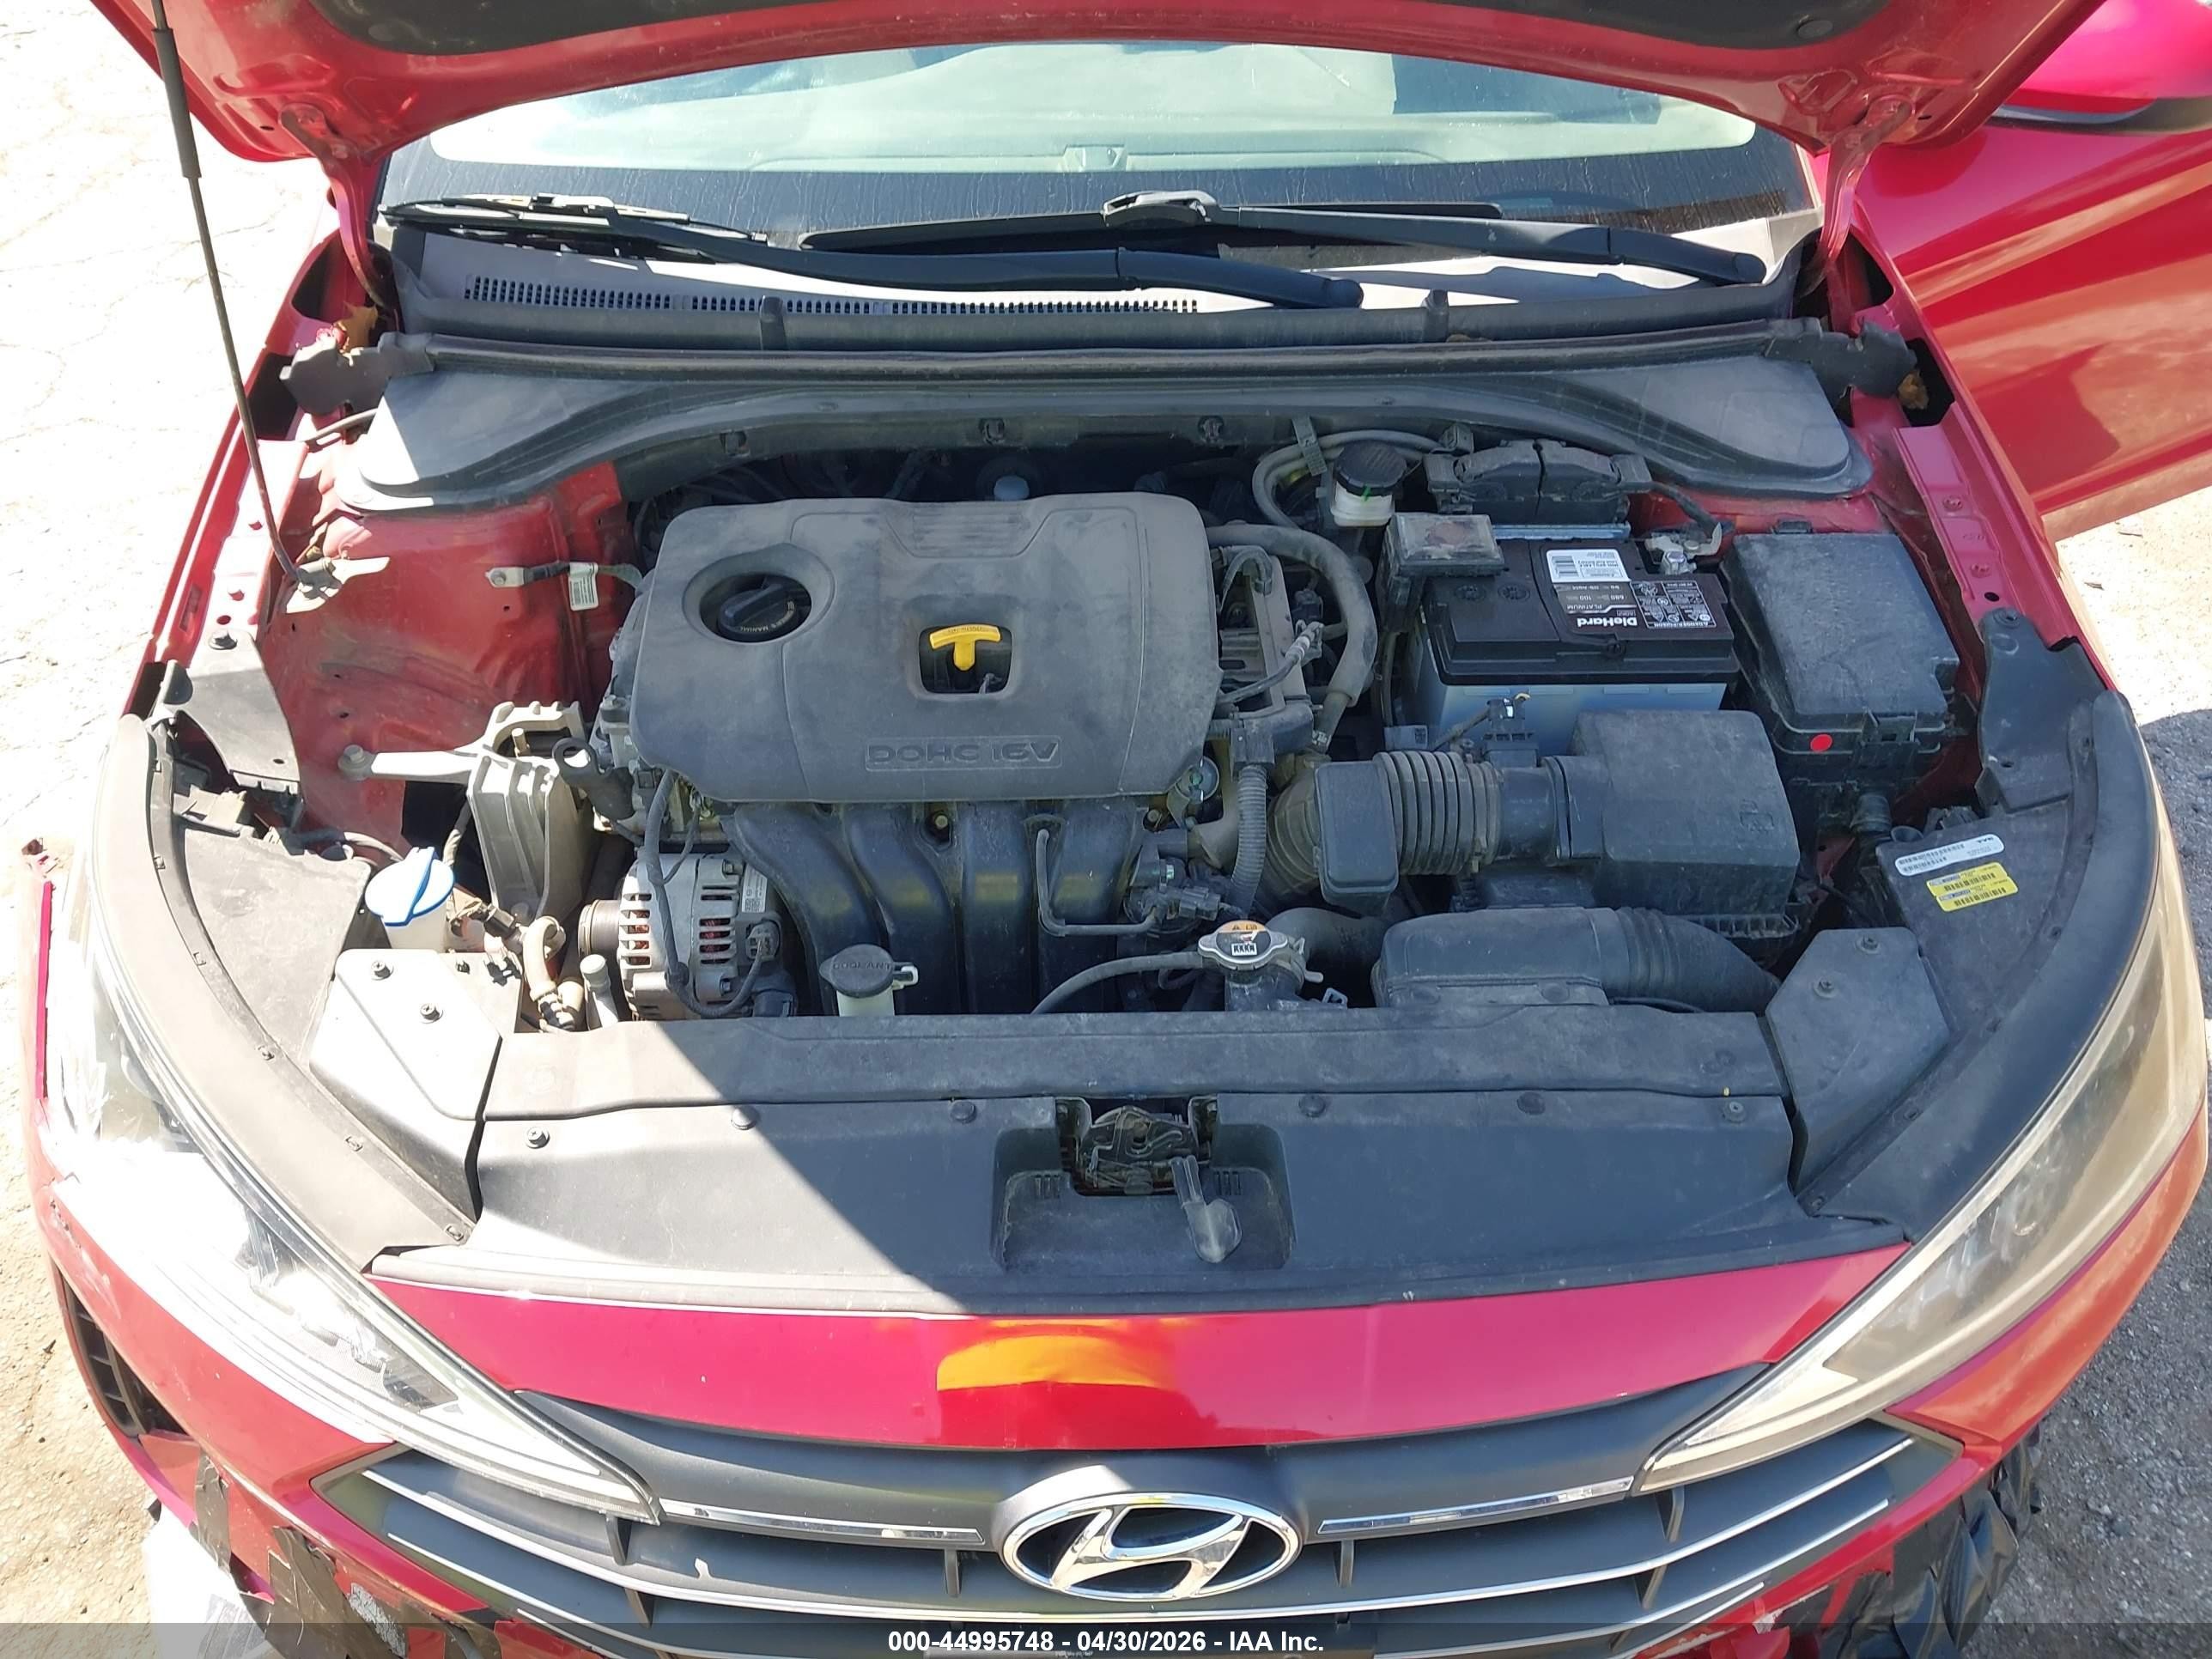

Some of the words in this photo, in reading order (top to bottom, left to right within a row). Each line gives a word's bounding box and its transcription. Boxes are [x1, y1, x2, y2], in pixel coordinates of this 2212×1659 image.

[1577, 617, 1638, 628] DieHard
[868, 743, 981, 764] DOHC
[991, 740, 1059, 763] 16V
[833, 961, 890, 971] COOLANT
